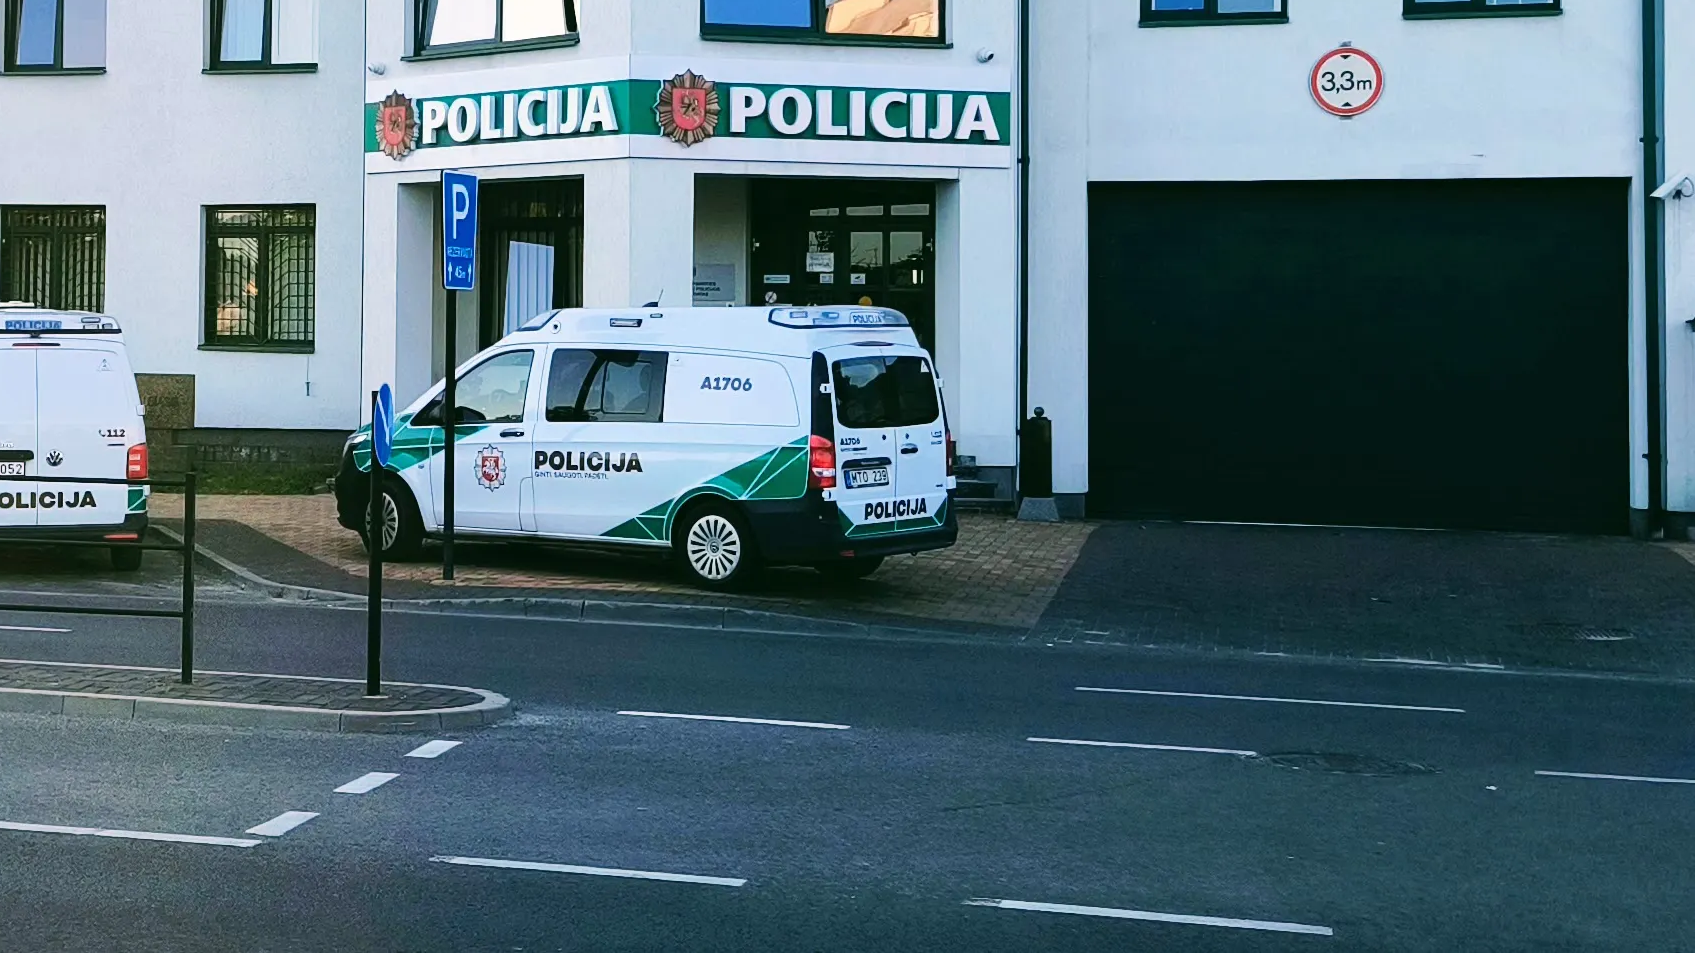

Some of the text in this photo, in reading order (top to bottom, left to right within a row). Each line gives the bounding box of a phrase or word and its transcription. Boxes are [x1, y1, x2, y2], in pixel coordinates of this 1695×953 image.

[1321, 70, 1372, 94] 3,3m
[422, 85, 618, 144] POLICIJA
[729, 86, 1000, 141] POLICIJA
[451, 183, 470, 240] P
[5, 320, 62, 330] POLICIJA
[700, 376, 753, 392] A1706
[106, 428, 126, 438] 112
[0, 463, 23, 475] 052
[534, 450, 644, 473] POLICIJA
[851, 471, 869, 484] MTO
[864, 497, 927, 520] POLICIJA
